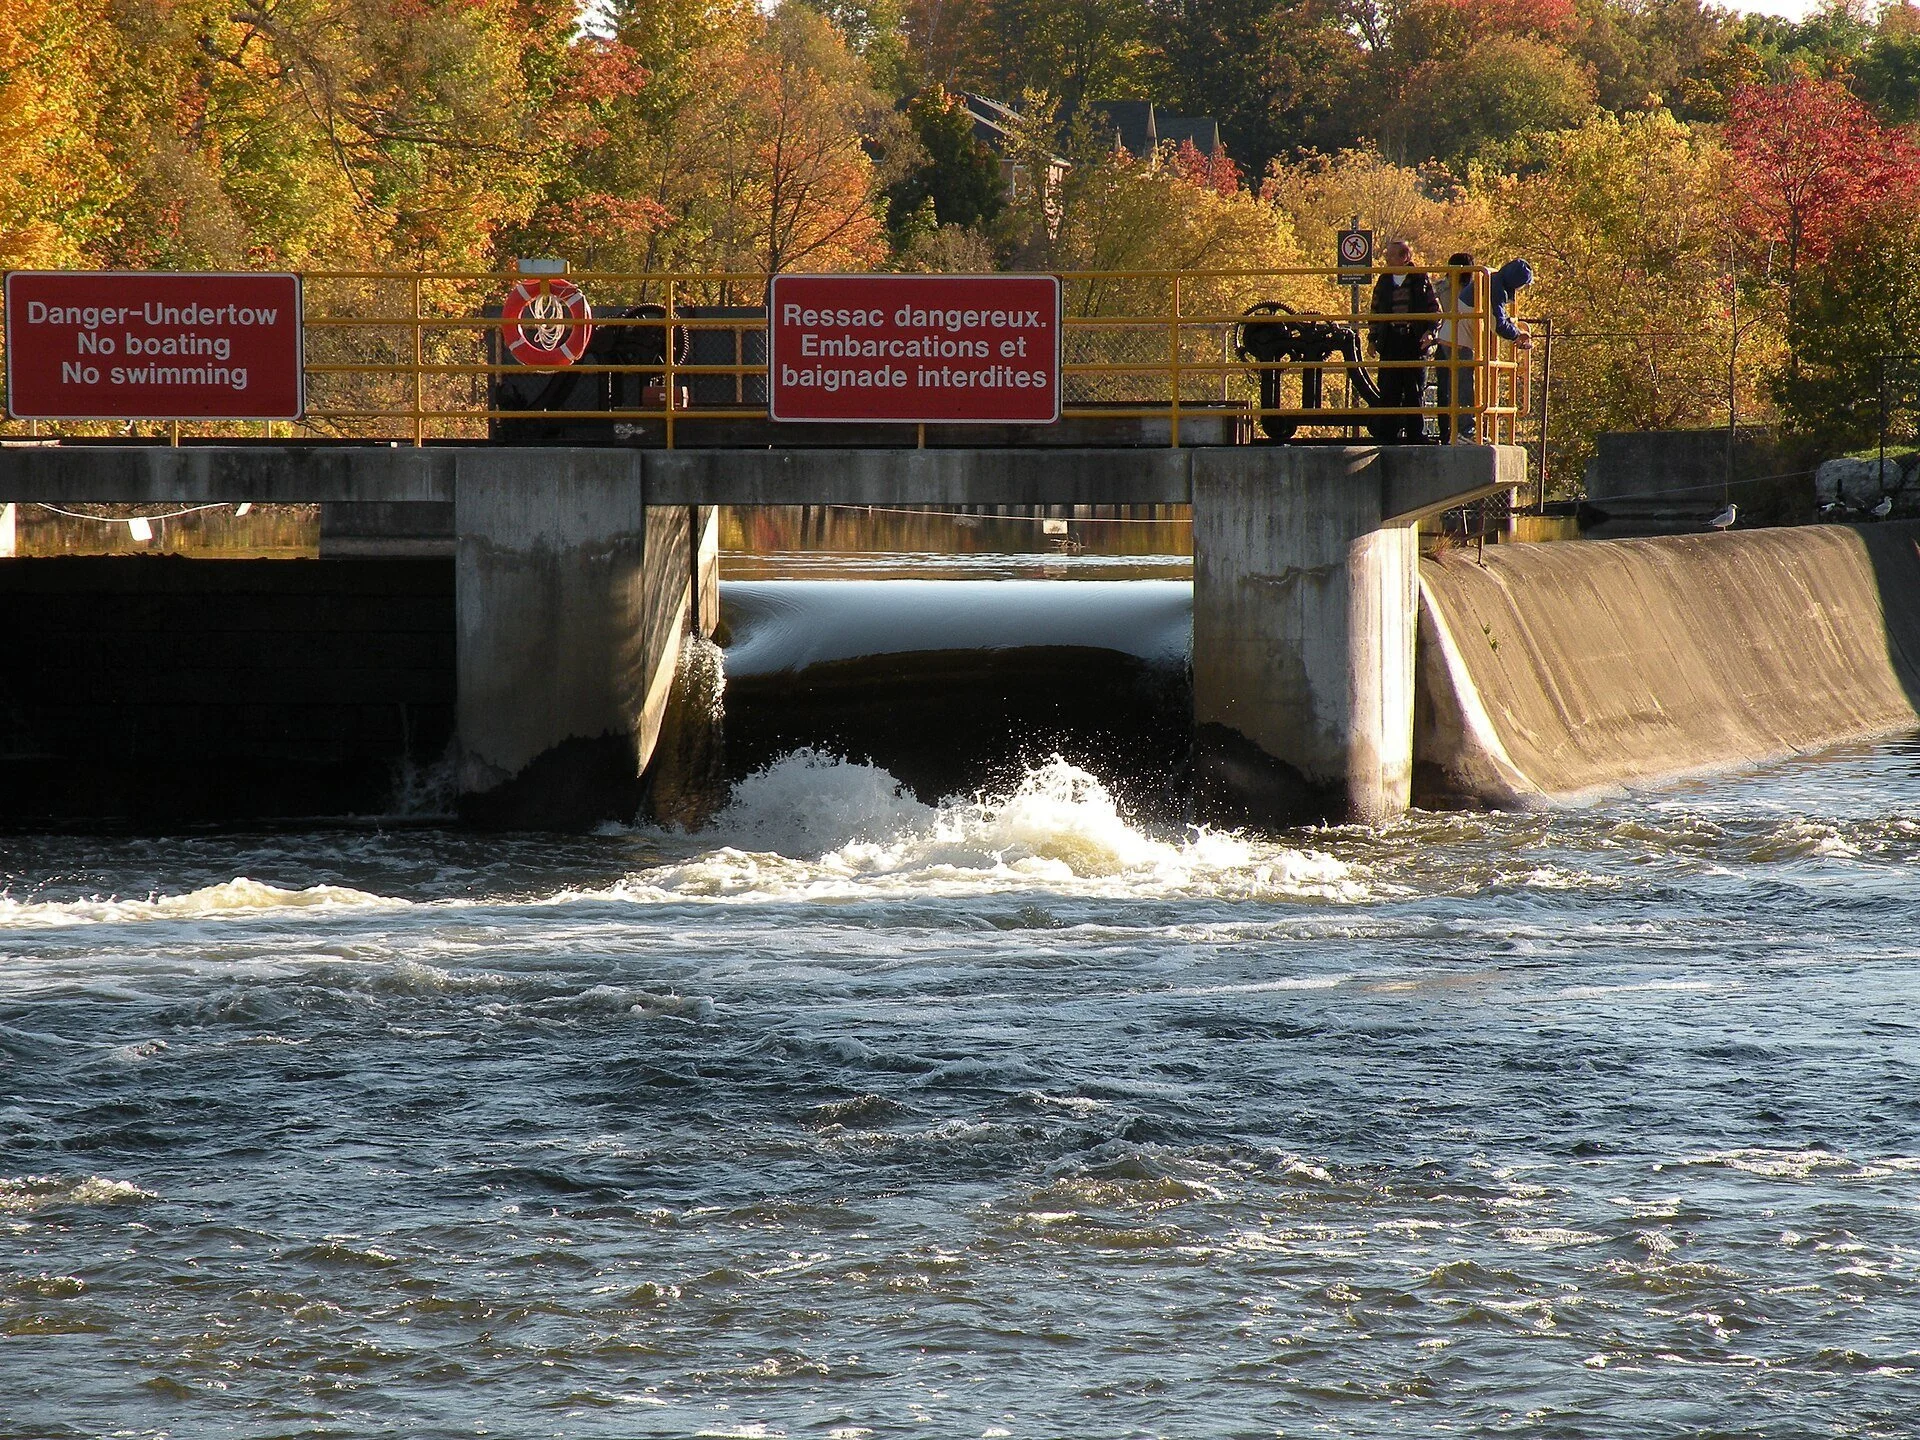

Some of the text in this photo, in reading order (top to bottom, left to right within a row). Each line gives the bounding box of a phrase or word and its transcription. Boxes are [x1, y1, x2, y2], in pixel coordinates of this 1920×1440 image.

[28, 302, 278, 330] Danger-Undertow
[784, 304, 1047, 333] Ressac dangereux.
[77, 332, 231, 360] No boating
[802, 334, 1027, 358] Embarcations et
[62, 361, 248, 390] No swimming
[782, 364, 1047, 392] baignade interdites
